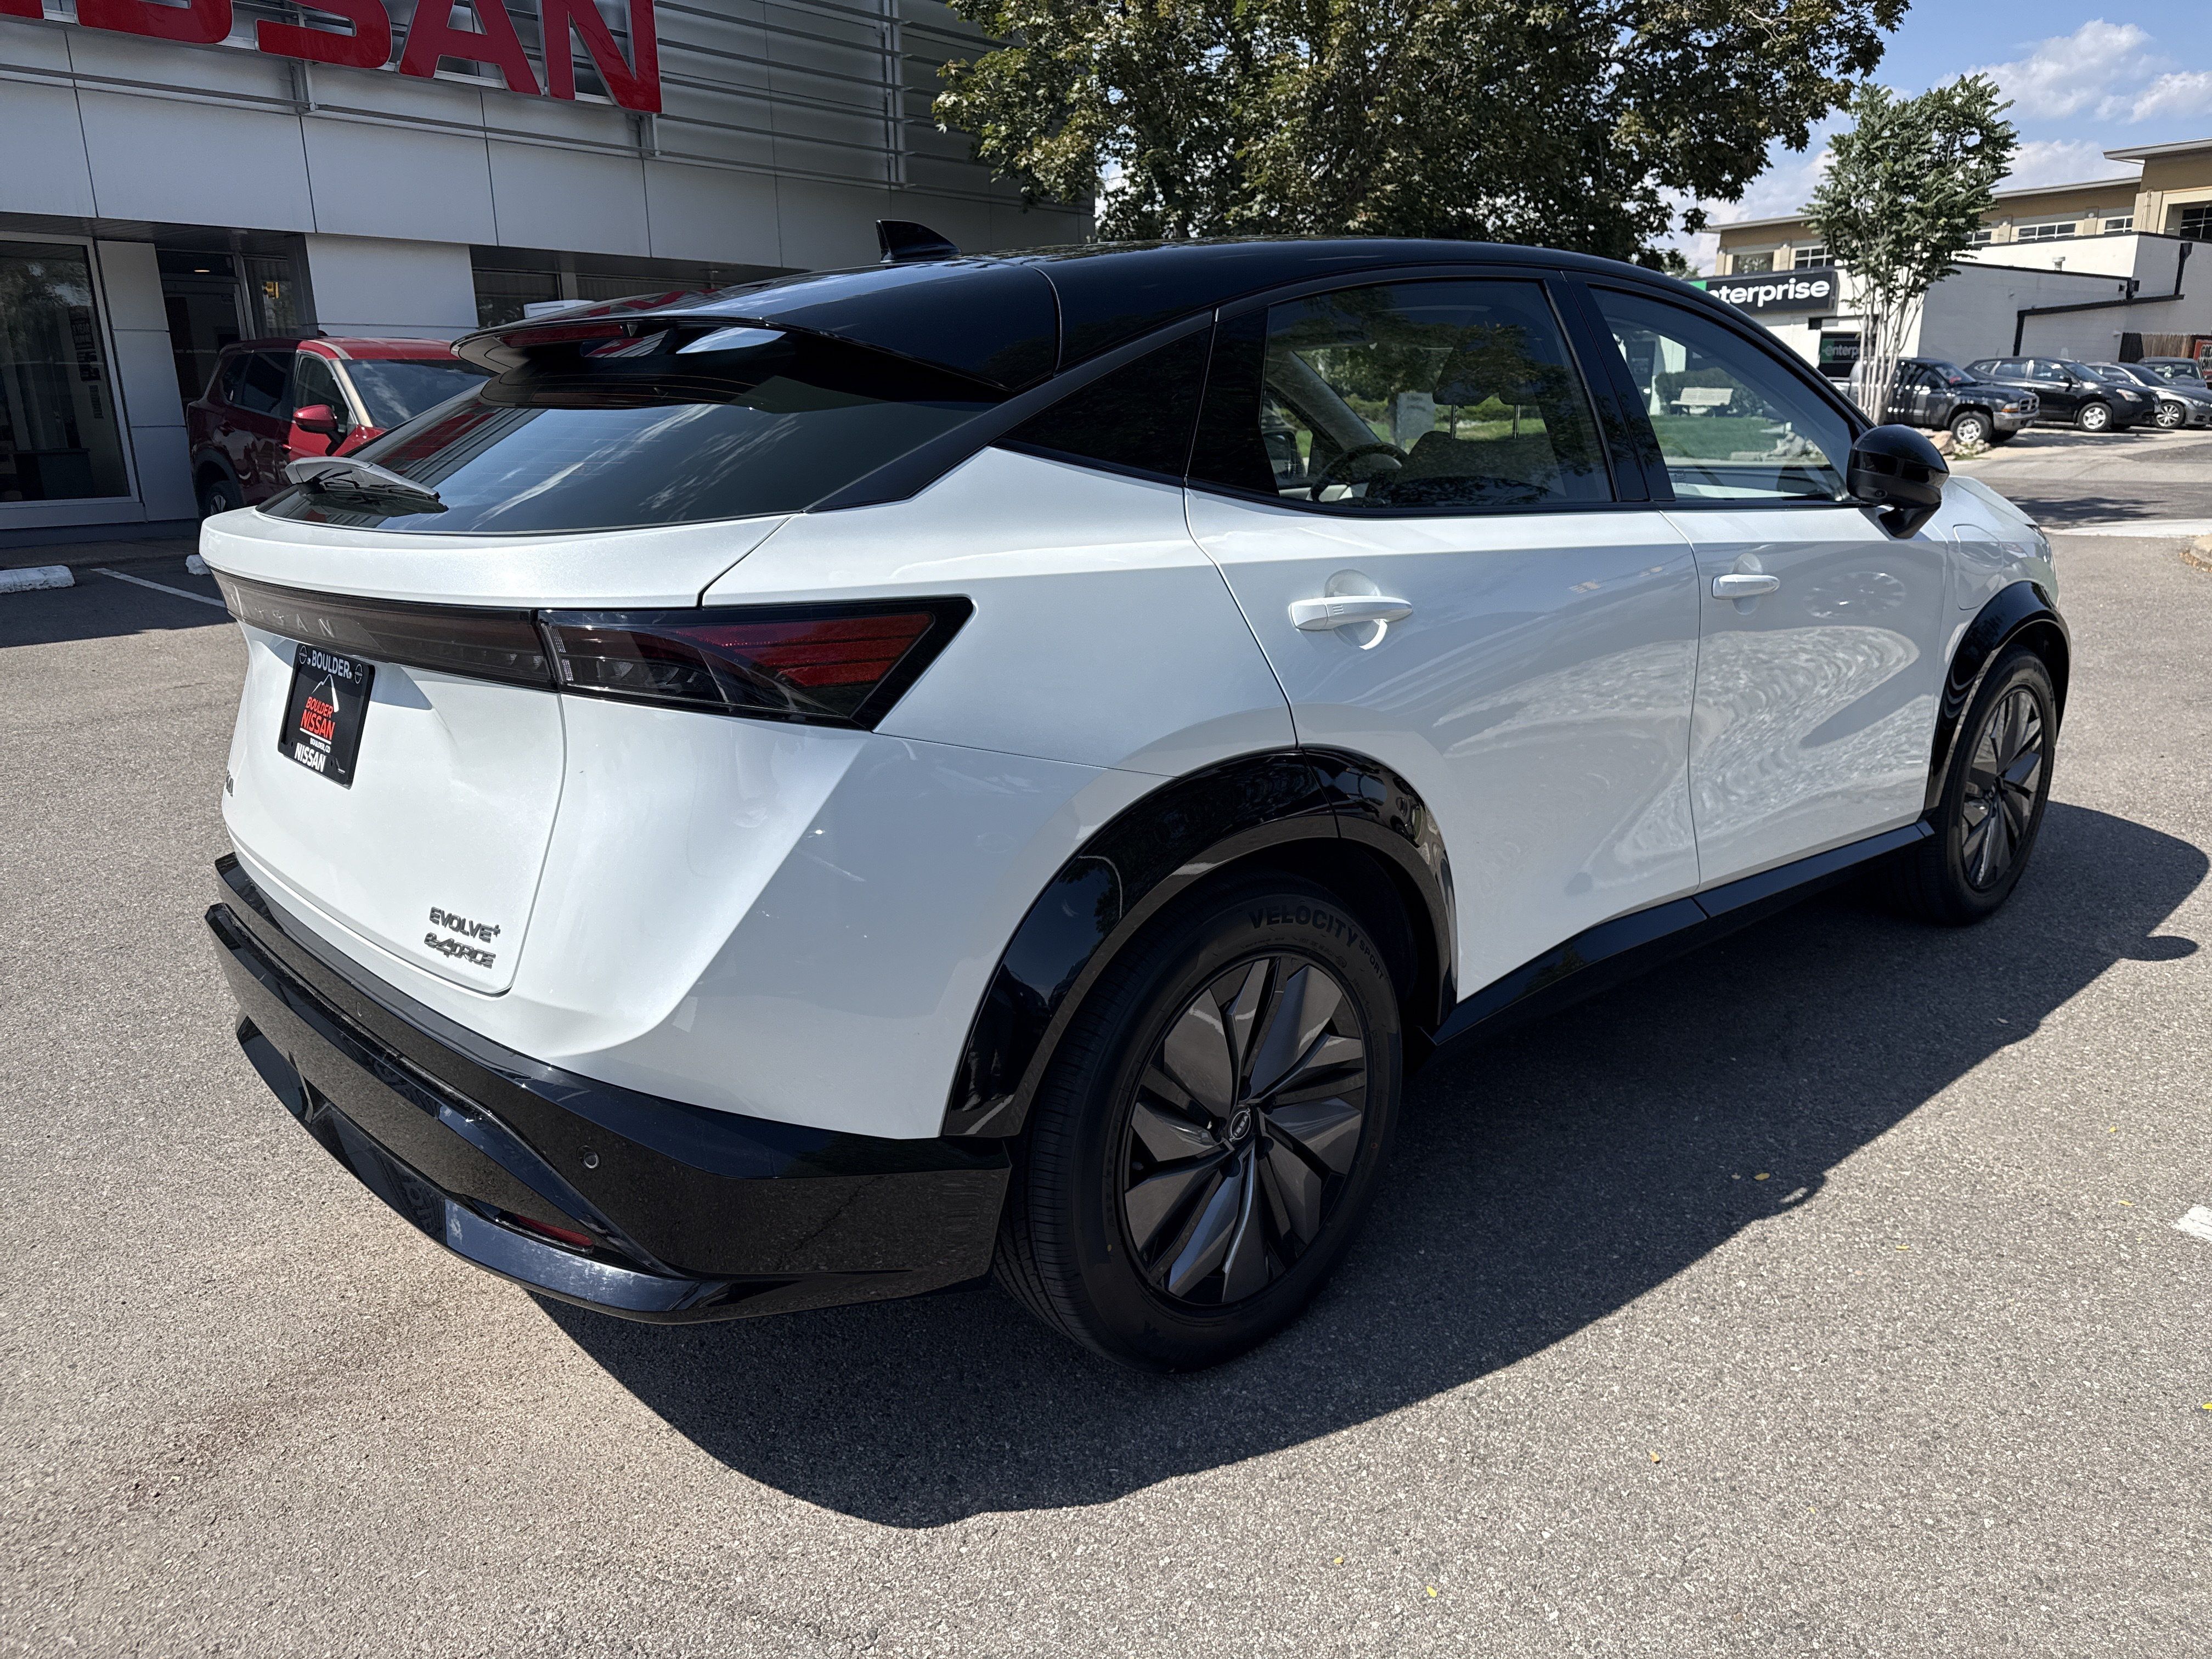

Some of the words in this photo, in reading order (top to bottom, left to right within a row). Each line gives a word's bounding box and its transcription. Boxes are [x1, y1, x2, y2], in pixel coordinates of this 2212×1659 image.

[312, 650, 350, 679] BOULDER
[306, 697, 334, 718] BOULDER
[300, 709, 335, 740] NISSAN
[295, 742, 326, 772] NISSAN
[1249, 905, 1358, 947] VELOCITY
[1358, 939, 1384, 979] SPORT
